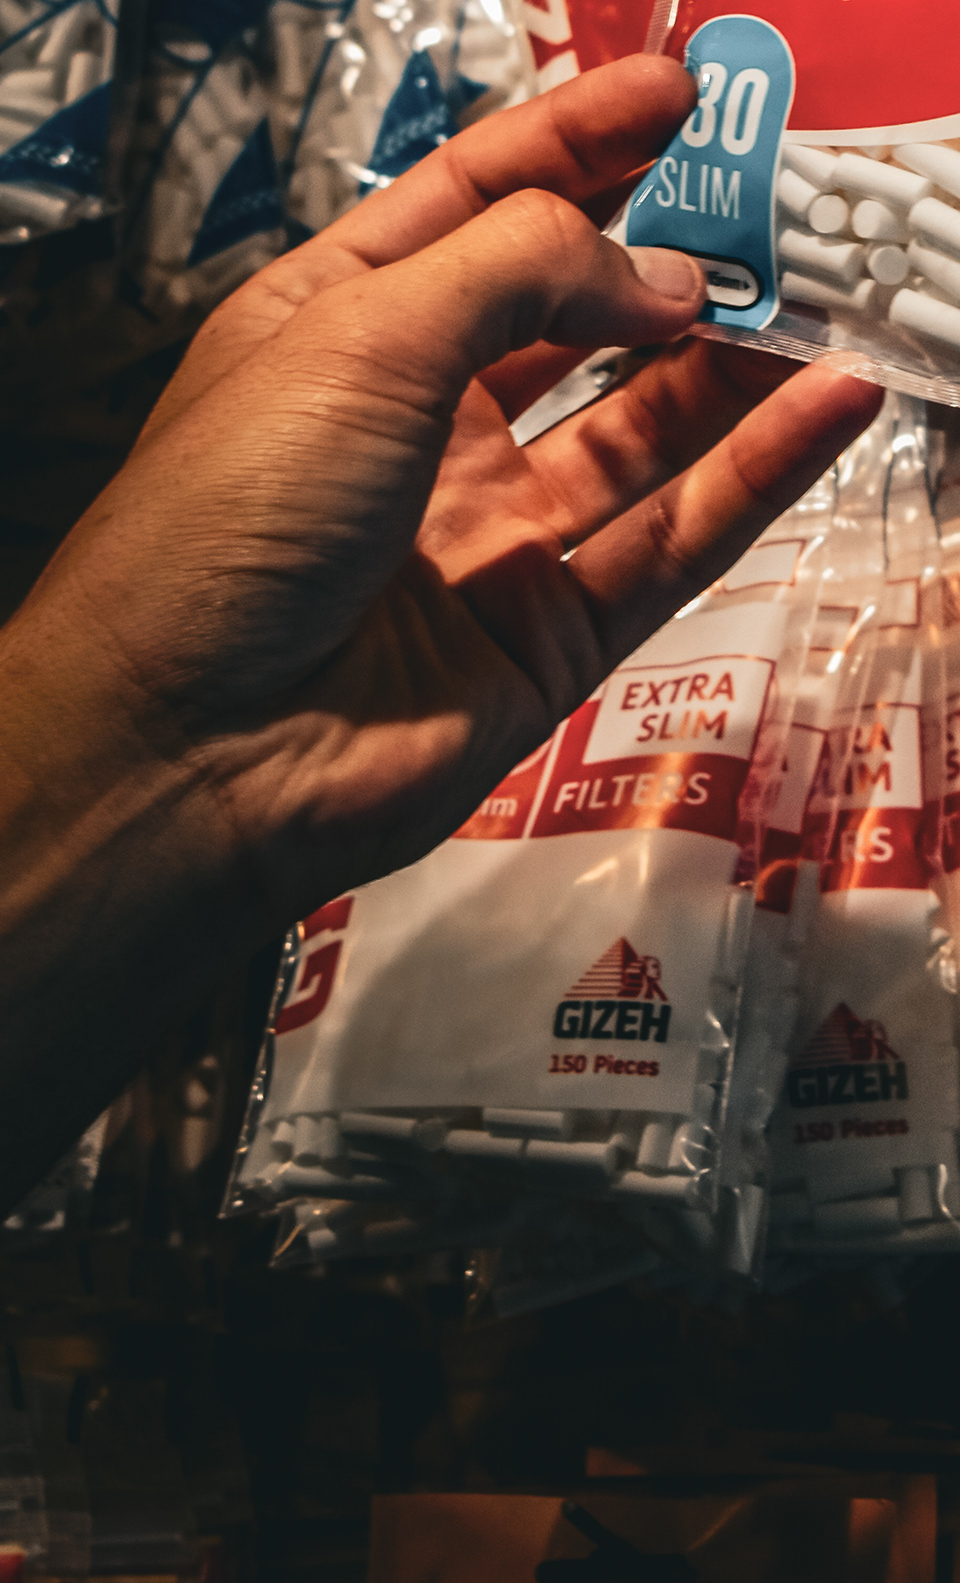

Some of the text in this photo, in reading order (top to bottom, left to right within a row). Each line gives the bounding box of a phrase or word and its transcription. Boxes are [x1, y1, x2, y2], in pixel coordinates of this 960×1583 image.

[681, 61, 770, 156] 80
[655, 155, 742, 220] SLIM
[620, 671, 735, 711] EXTRA
[636, 709, 728, 743] SLIM
[553, 771, 712, 814] FILTERS
[552, 1000, 672, 1043] GIZEH
[548, 1053, 660, 1077] 150 Pieces
[786, 1061, 910, 1109] GIZEH
